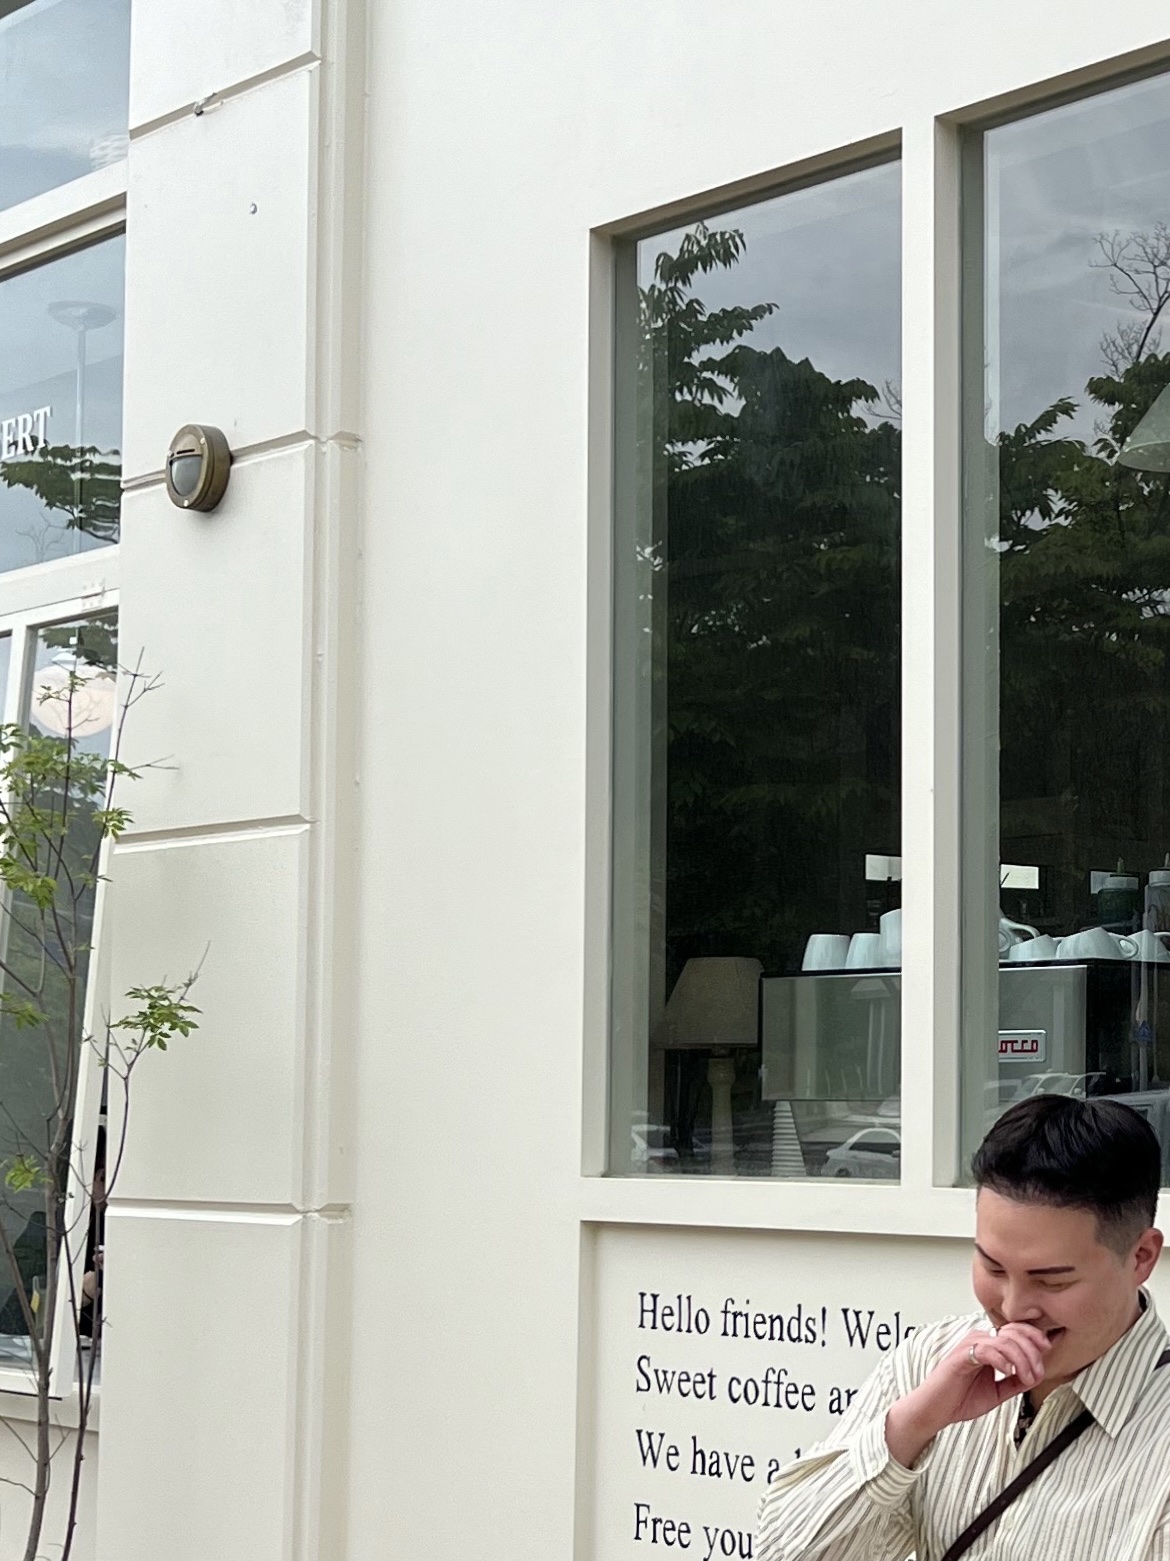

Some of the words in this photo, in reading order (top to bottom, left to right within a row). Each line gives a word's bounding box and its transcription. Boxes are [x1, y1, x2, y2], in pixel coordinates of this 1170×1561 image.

[638, 1291, 710, 1335] Hello
[720, 1297, 827, 1348] friends!
[636, 1354, 717, 1401] Sweet
[727, 1367, 816, 1412] coffee
[635, 1429, 680, 1472] We
[690, 1435, 755, 1483] have
[633, 1502, 691, 1549] Free
